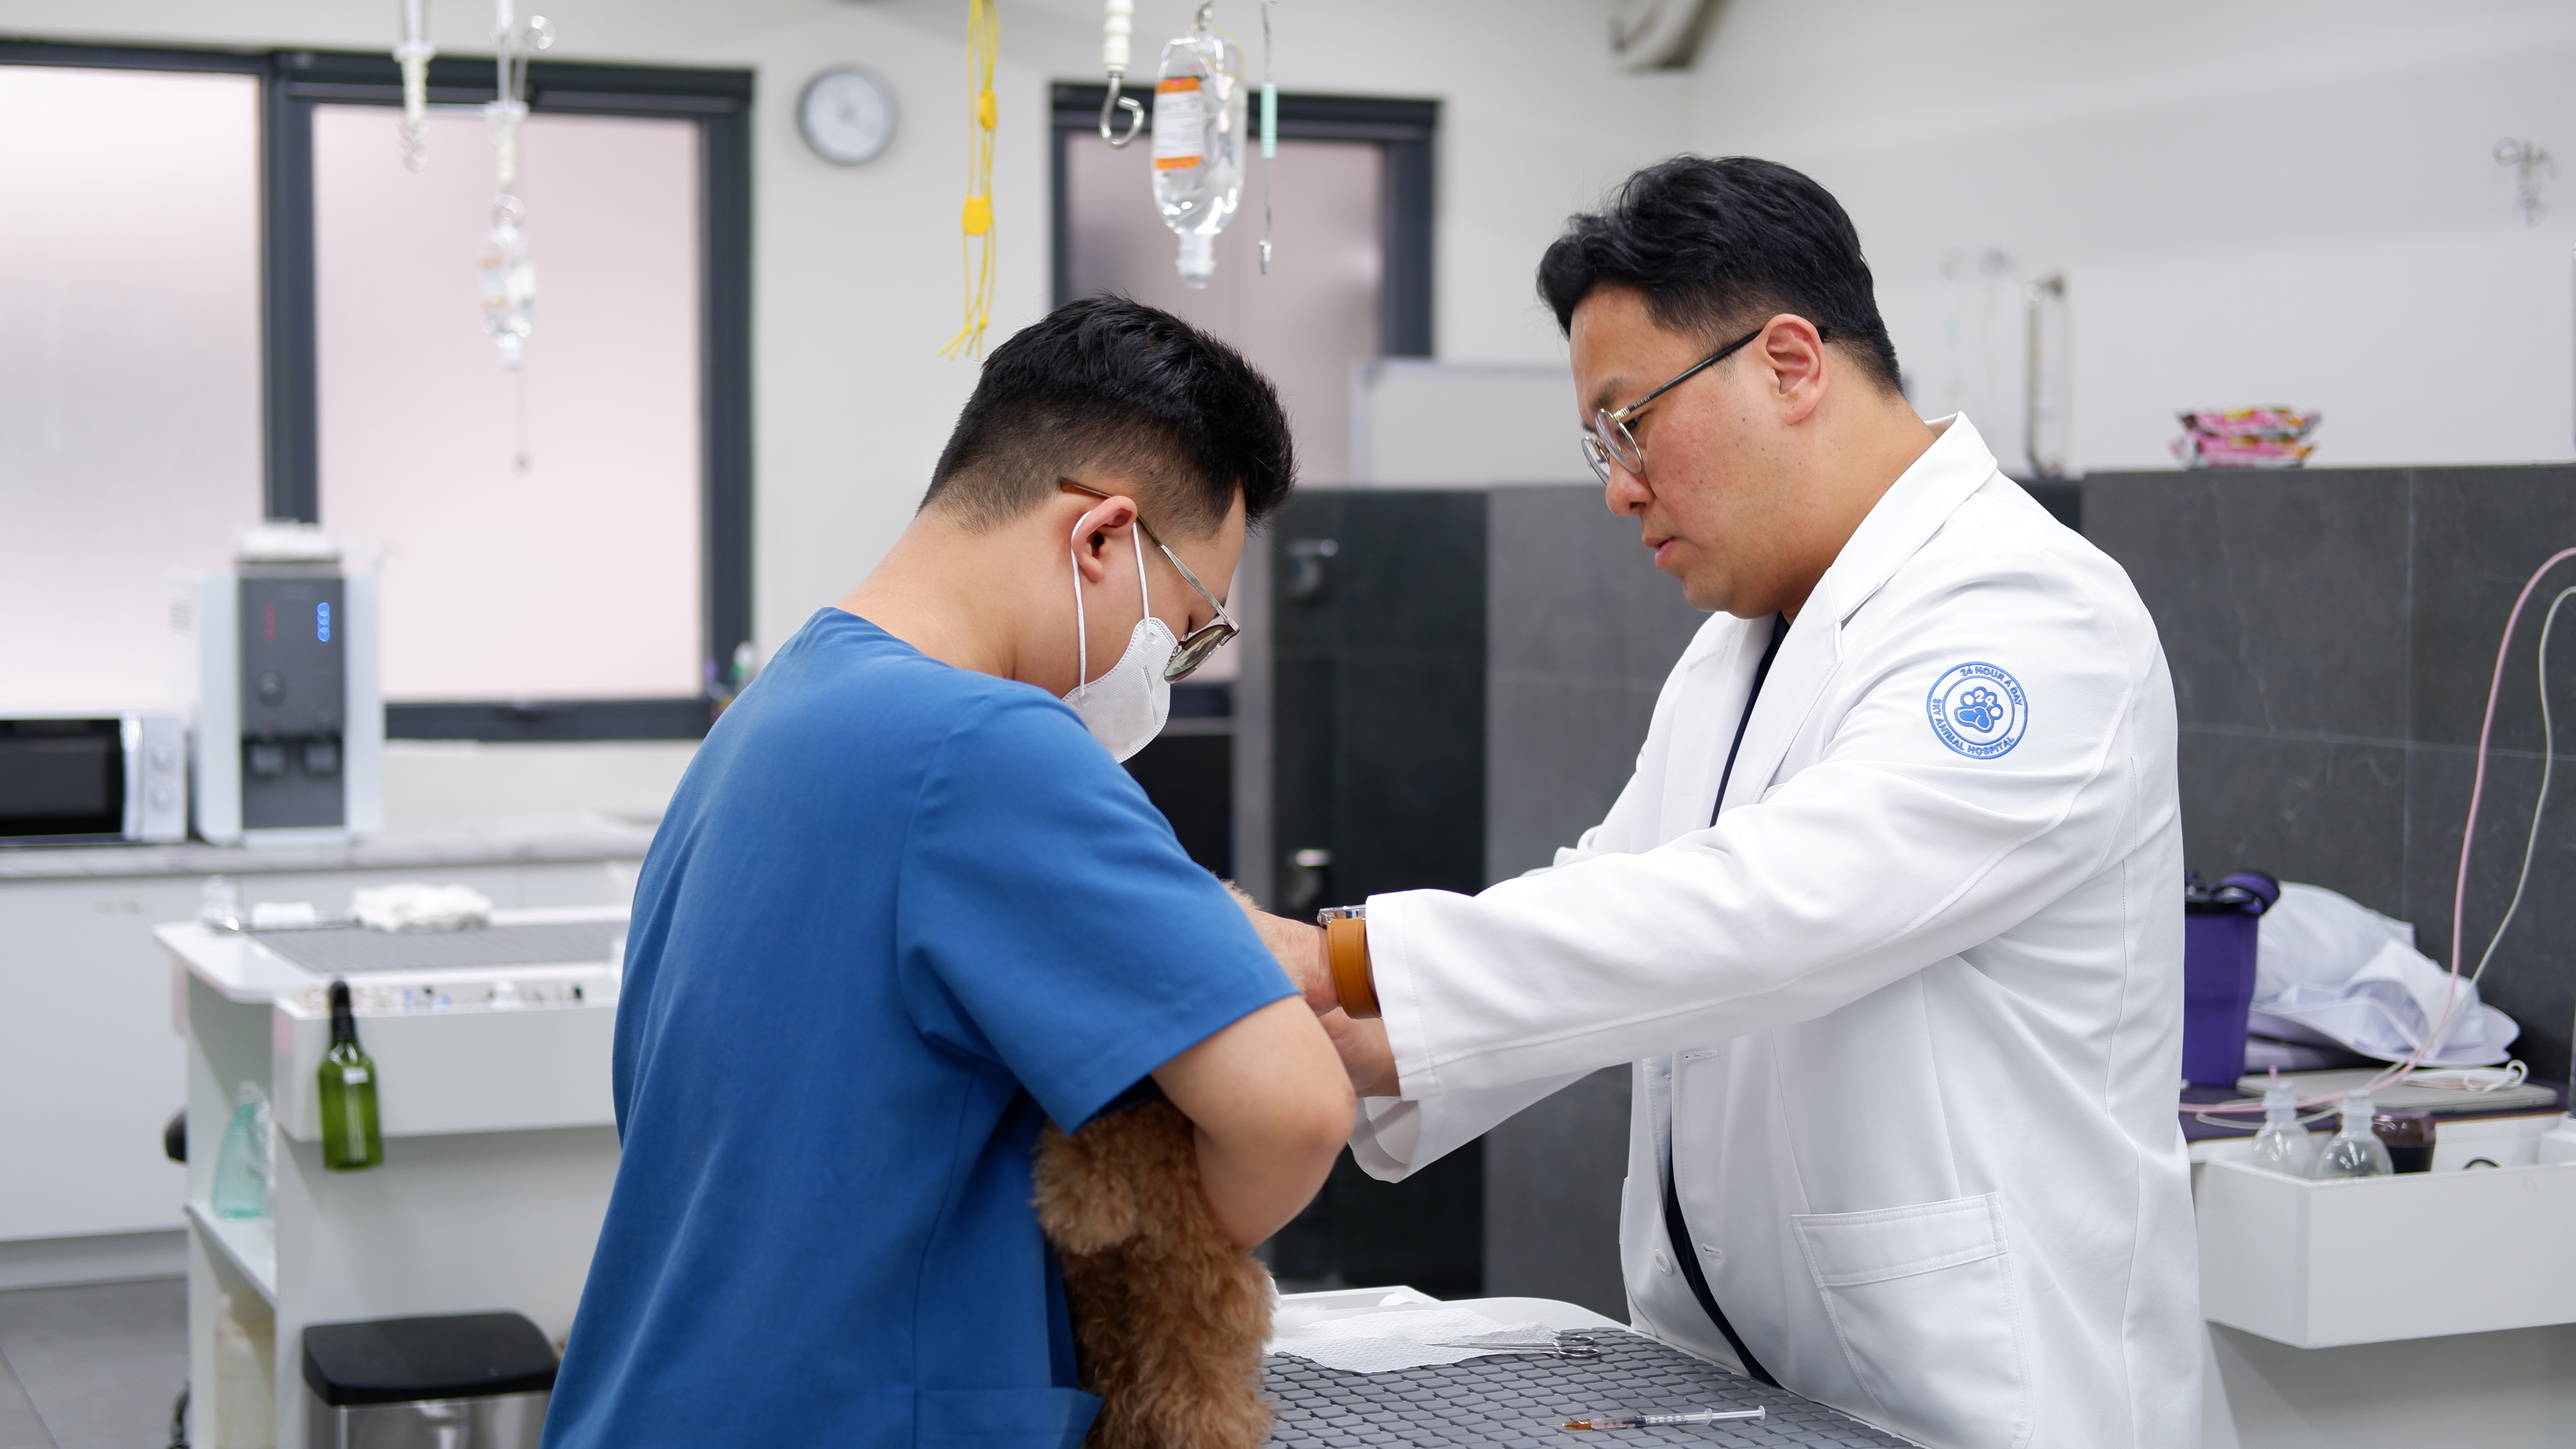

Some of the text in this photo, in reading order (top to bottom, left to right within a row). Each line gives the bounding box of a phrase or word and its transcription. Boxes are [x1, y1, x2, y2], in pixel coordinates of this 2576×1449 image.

[1960, 666, 1973, 676] 24
[1975, 666, 2005, 681] HOUR
[2010, 687, 2023, 706] DAY
[1932, 698, 2014, 755] SKY ANIMAL HOSPITAL
